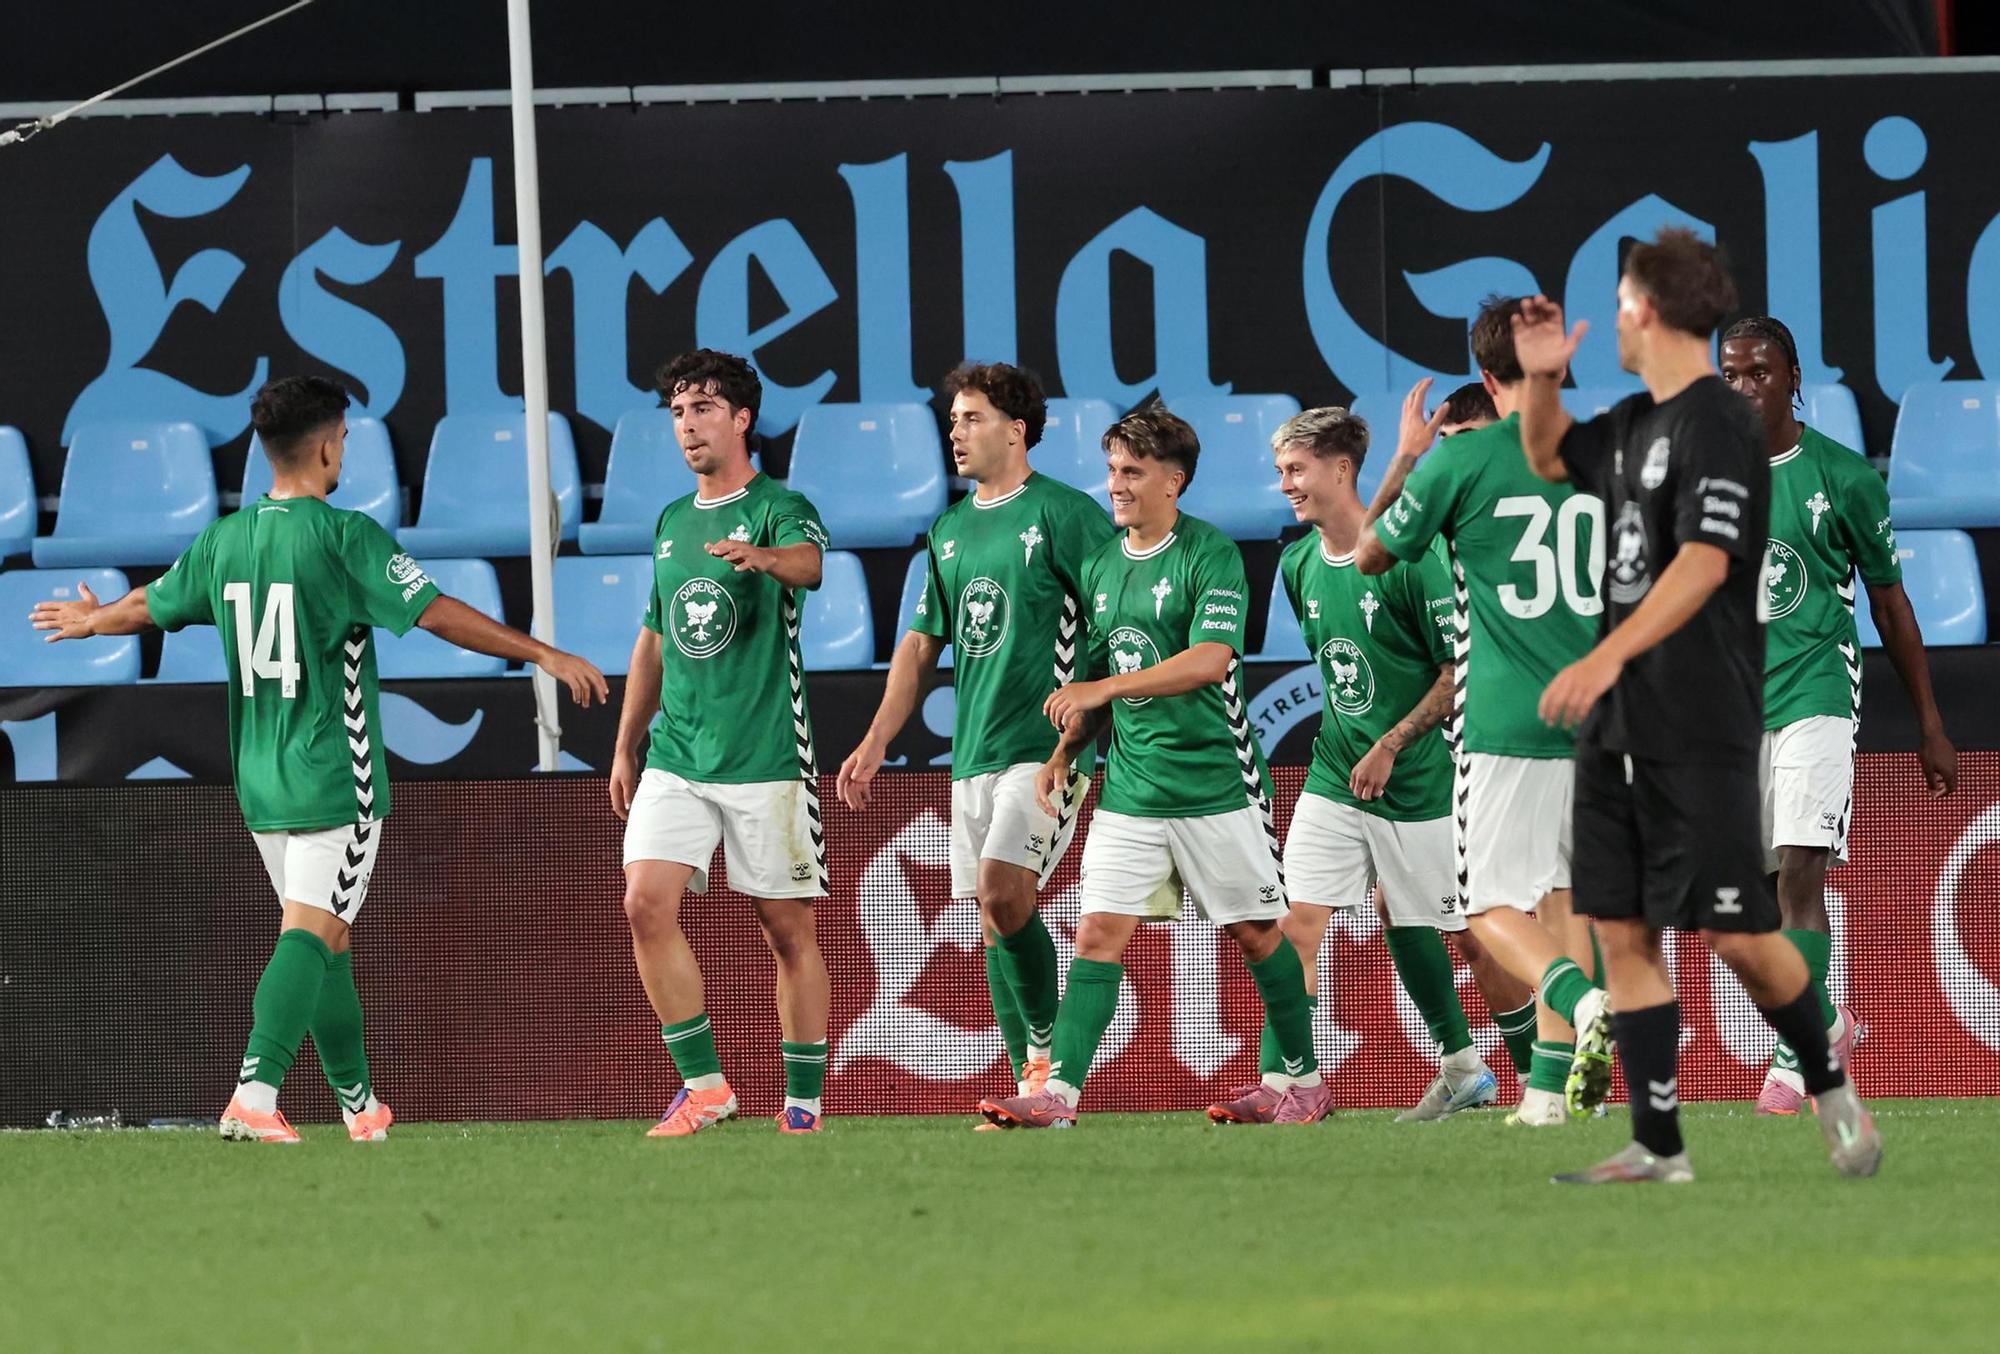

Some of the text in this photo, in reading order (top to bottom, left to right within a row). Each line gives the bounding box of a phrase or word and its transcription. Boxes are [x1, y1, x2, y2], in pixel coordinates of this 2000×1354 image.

[61, 148, 1233, 448] Estrella
[680, 581, 722, 601] OURENSE
[1493, 493, 1606, 619] 30
[223, 582, 300, 698] 14
[1204, 603, 1238, 616] Siweb
[1254, 682, 1321, 739] STREL
